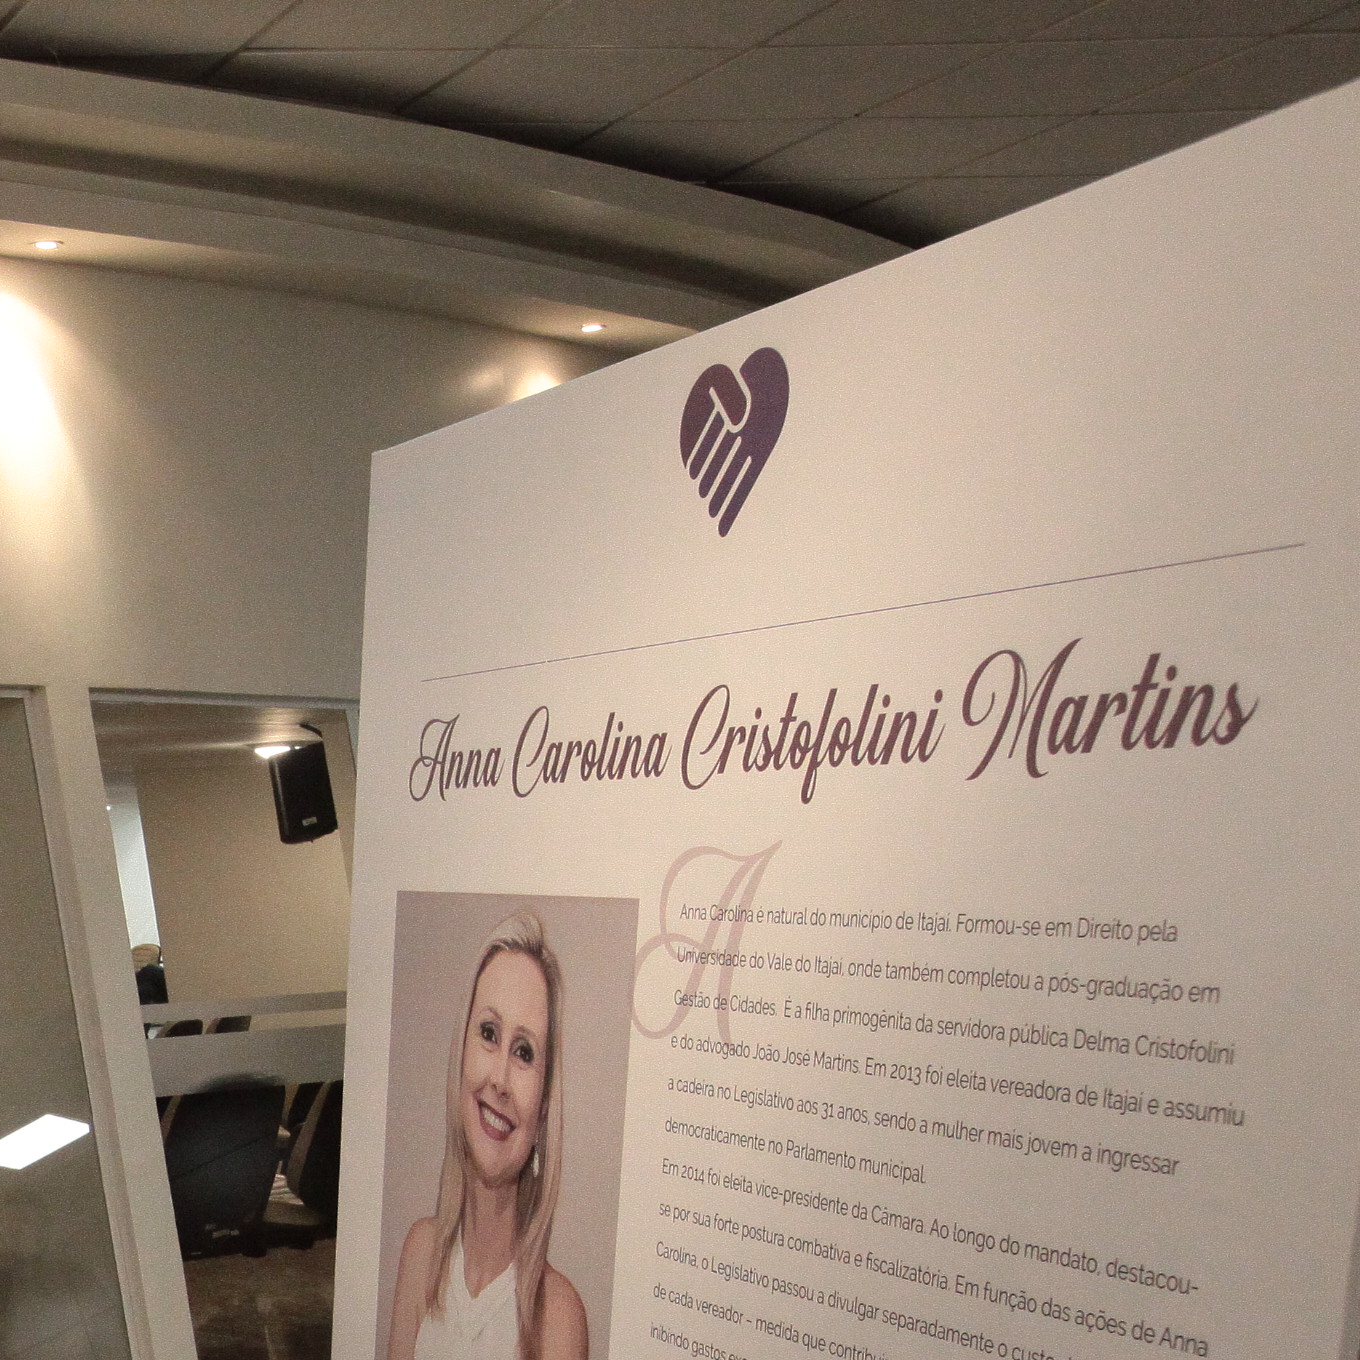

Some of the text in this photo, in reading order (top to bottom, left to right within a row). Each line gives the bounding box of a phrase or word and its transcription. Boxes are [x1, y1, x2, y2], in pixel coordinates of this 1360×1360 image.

[409, 638, 1261, 804] Anna Carolina Cristofolini Martins
[680, 903, 706, 920] Anna
[709, 900, 754, 924] Carolina
[756, 909, 764, 923] é
[766, 907, 807, 925] natural
[809, 908, 826, 927] do
[829, 912, 892, 933] município
[895, 910, 914, 931] de
[955, 912, 1041, 937] Formou-se
[1044, 920, 1072, 938] em
[1076, 916, 1133, 941] Direito
[1136, 918, 1178, 946] pela
[664, 1117, 765, 1152] democraticamente
[767, 1139, 783, 1155] no
[785, 1138, 856, 1170] Parlamento
[650, 1324, 689, 1350] inibindo
